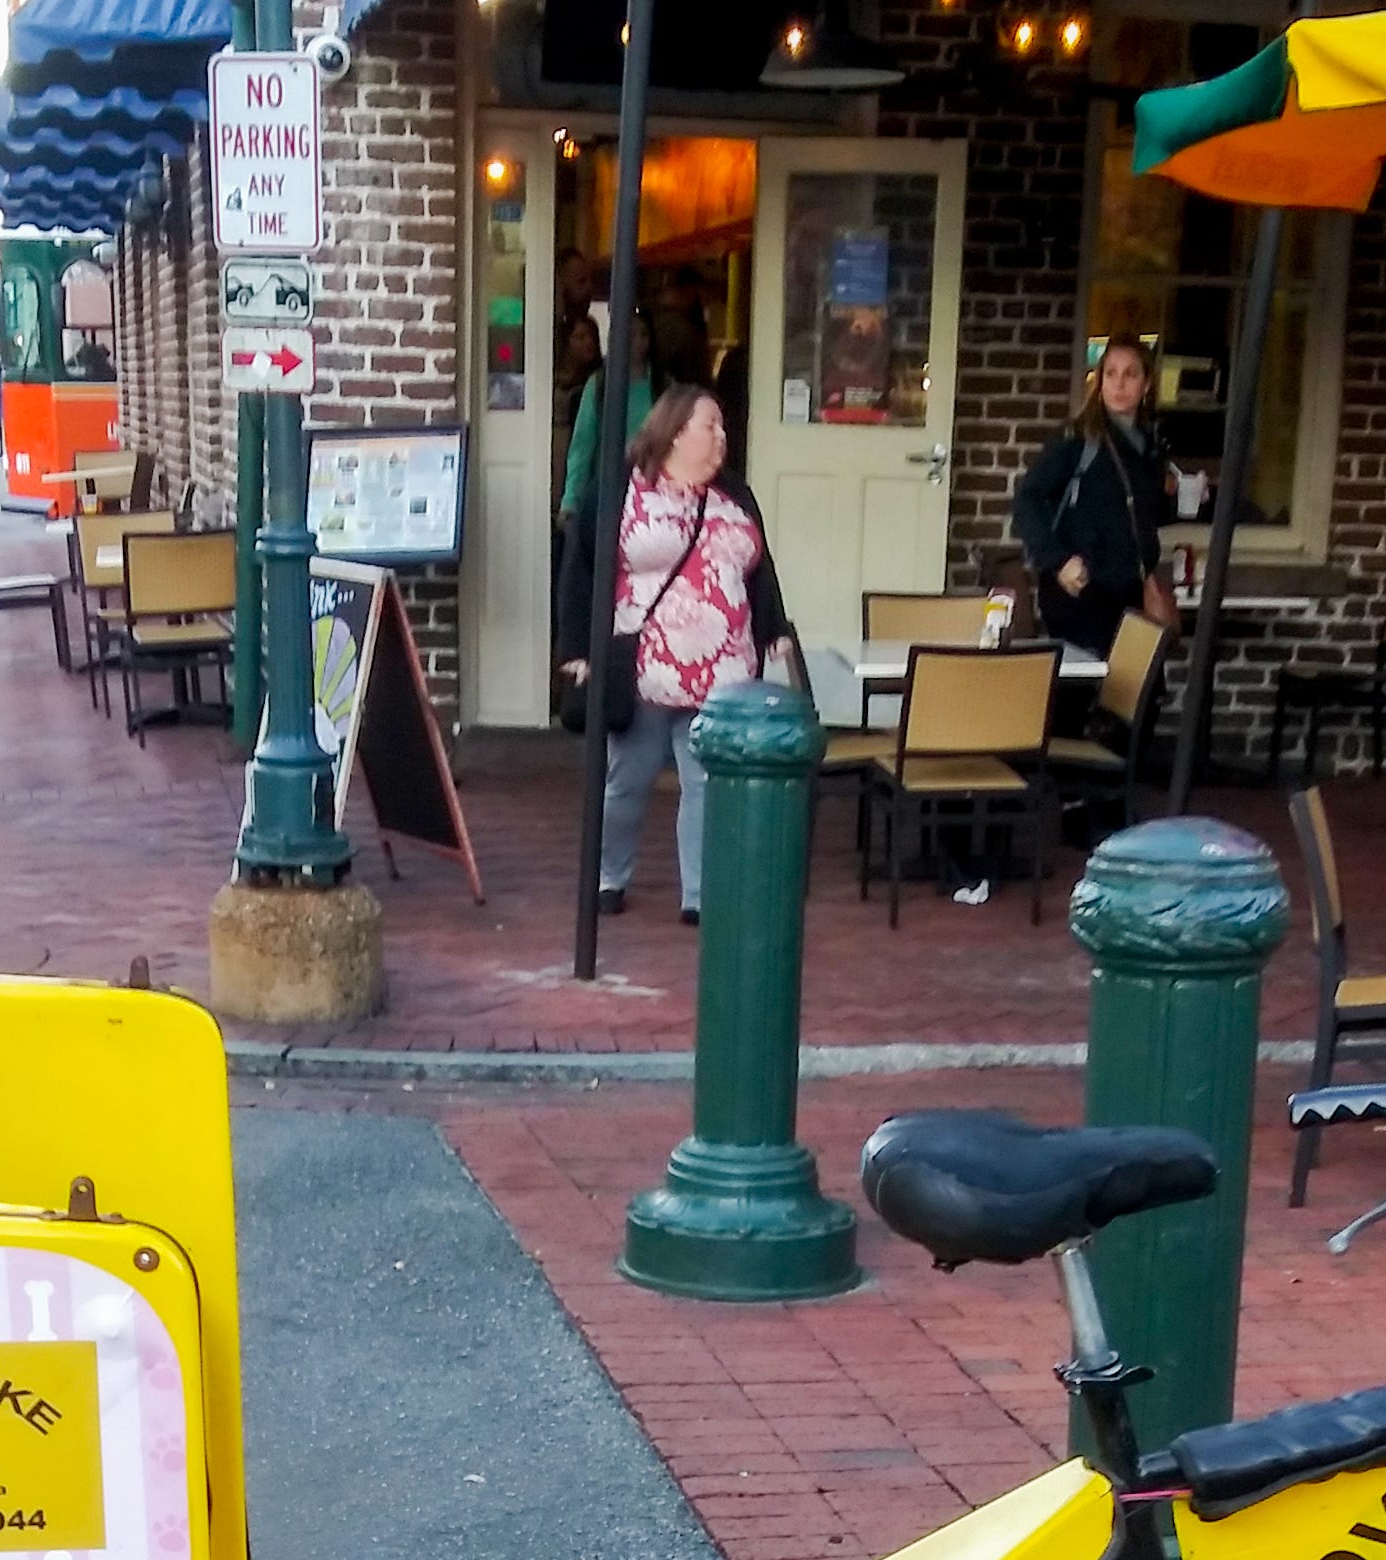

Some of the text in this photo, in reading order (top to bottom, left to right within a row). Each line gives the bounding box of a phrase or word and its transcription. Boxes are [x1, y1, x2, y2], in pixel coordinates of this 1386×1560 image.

[247, 73, 284, 108] NO
[221, 123, 311, 160] PARKING
[248, 173, 285, 197] ANY
[248, 211, 288, 236] TIME
